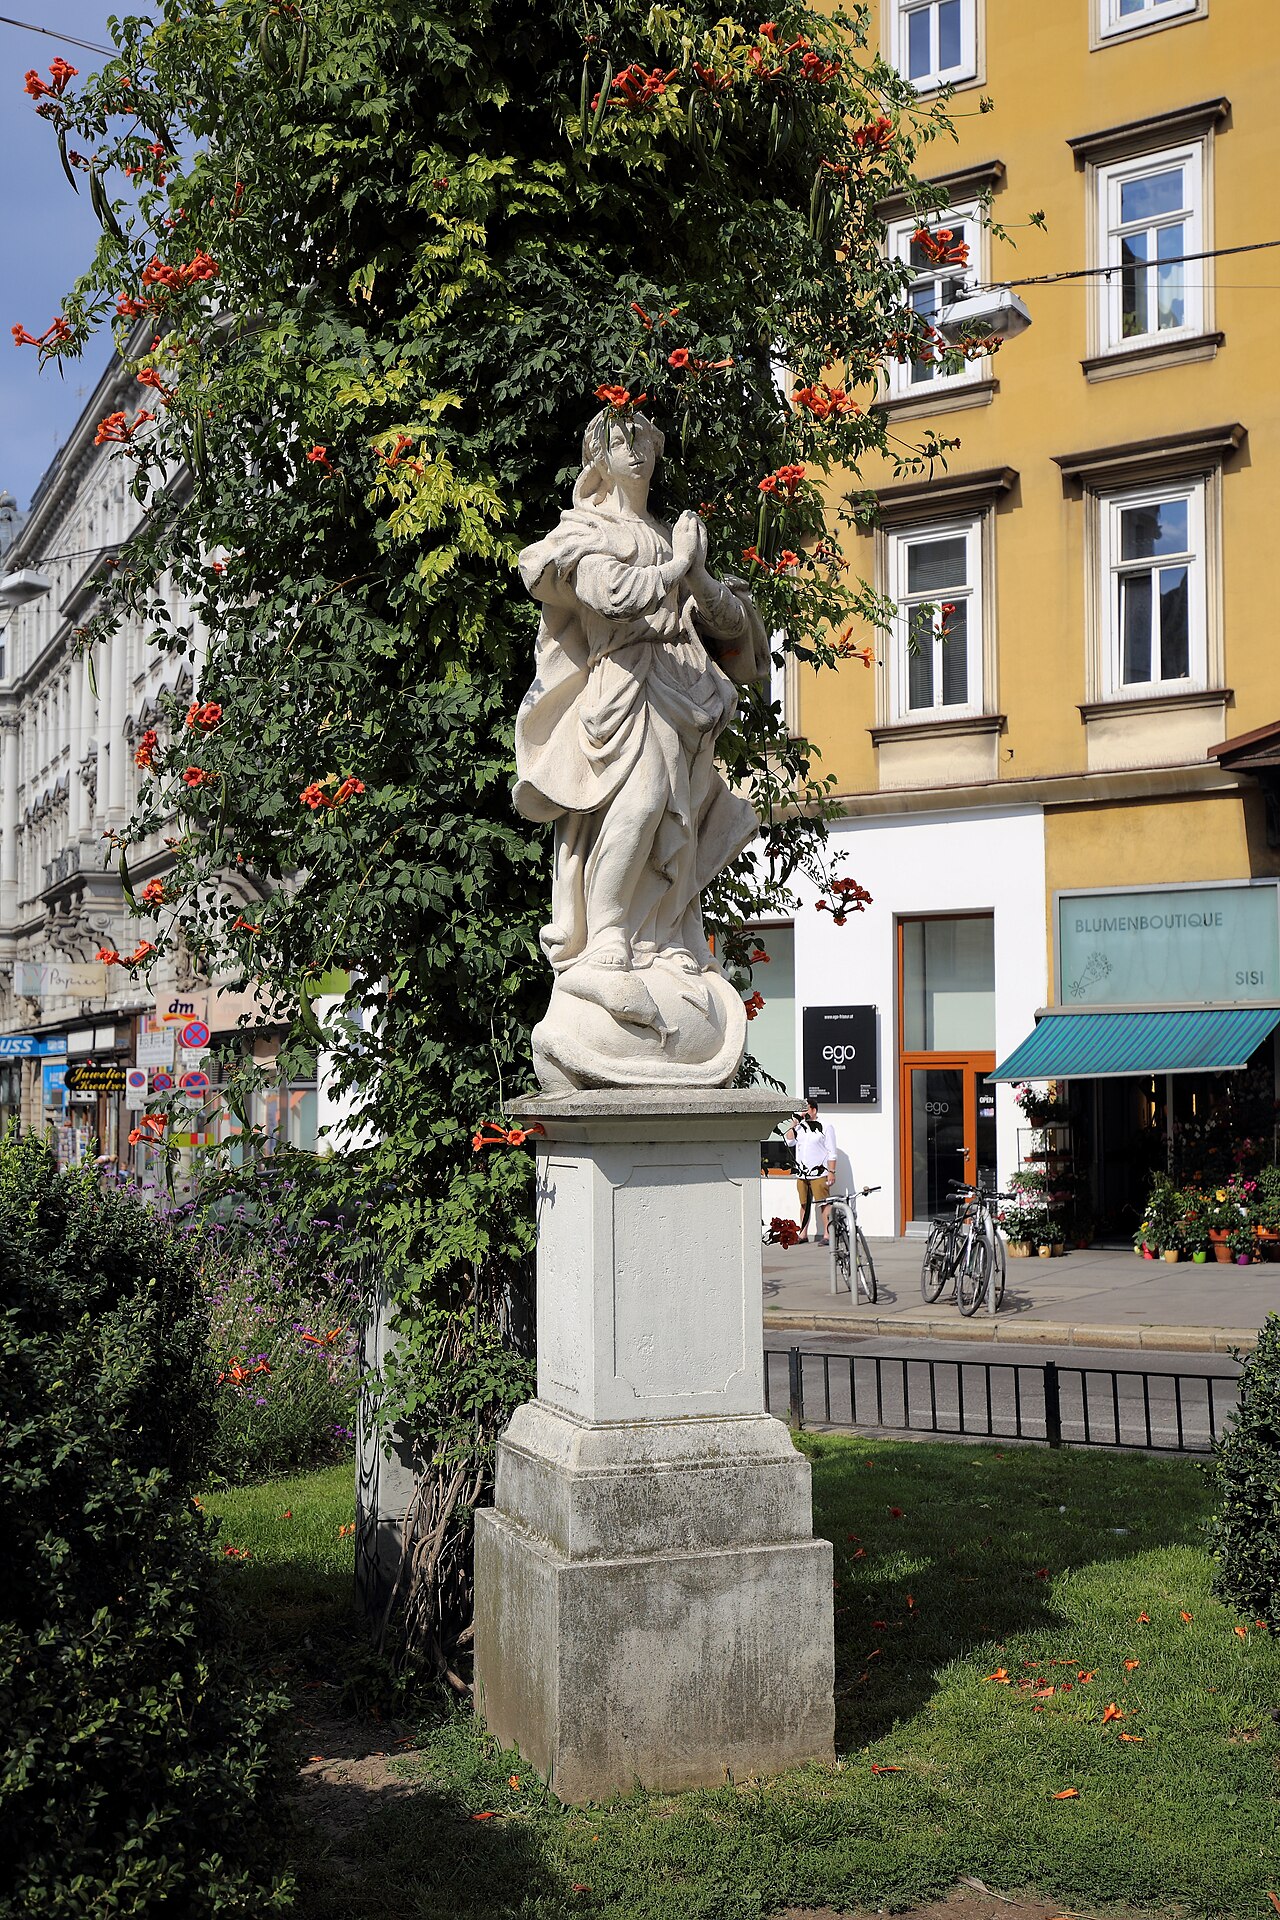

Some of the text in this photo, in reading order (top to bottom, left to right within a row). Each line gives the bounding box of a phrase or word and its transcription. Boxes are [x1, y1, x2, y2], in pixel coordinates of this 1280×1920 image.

[1075, 912, 1223, 933] BLUMENBOUTIQUE
[50, 968, 103, 989] Papier
[1235, 971, 1264, 985] SISI
[168, 999, 194, 1014] dm
[0, 1039, 33, 1054] USS
[822, 1045, 856, 1064] ego
[979, 1096, 994, 1104] OPEN
[925, 1102, 949, 1115] ego
